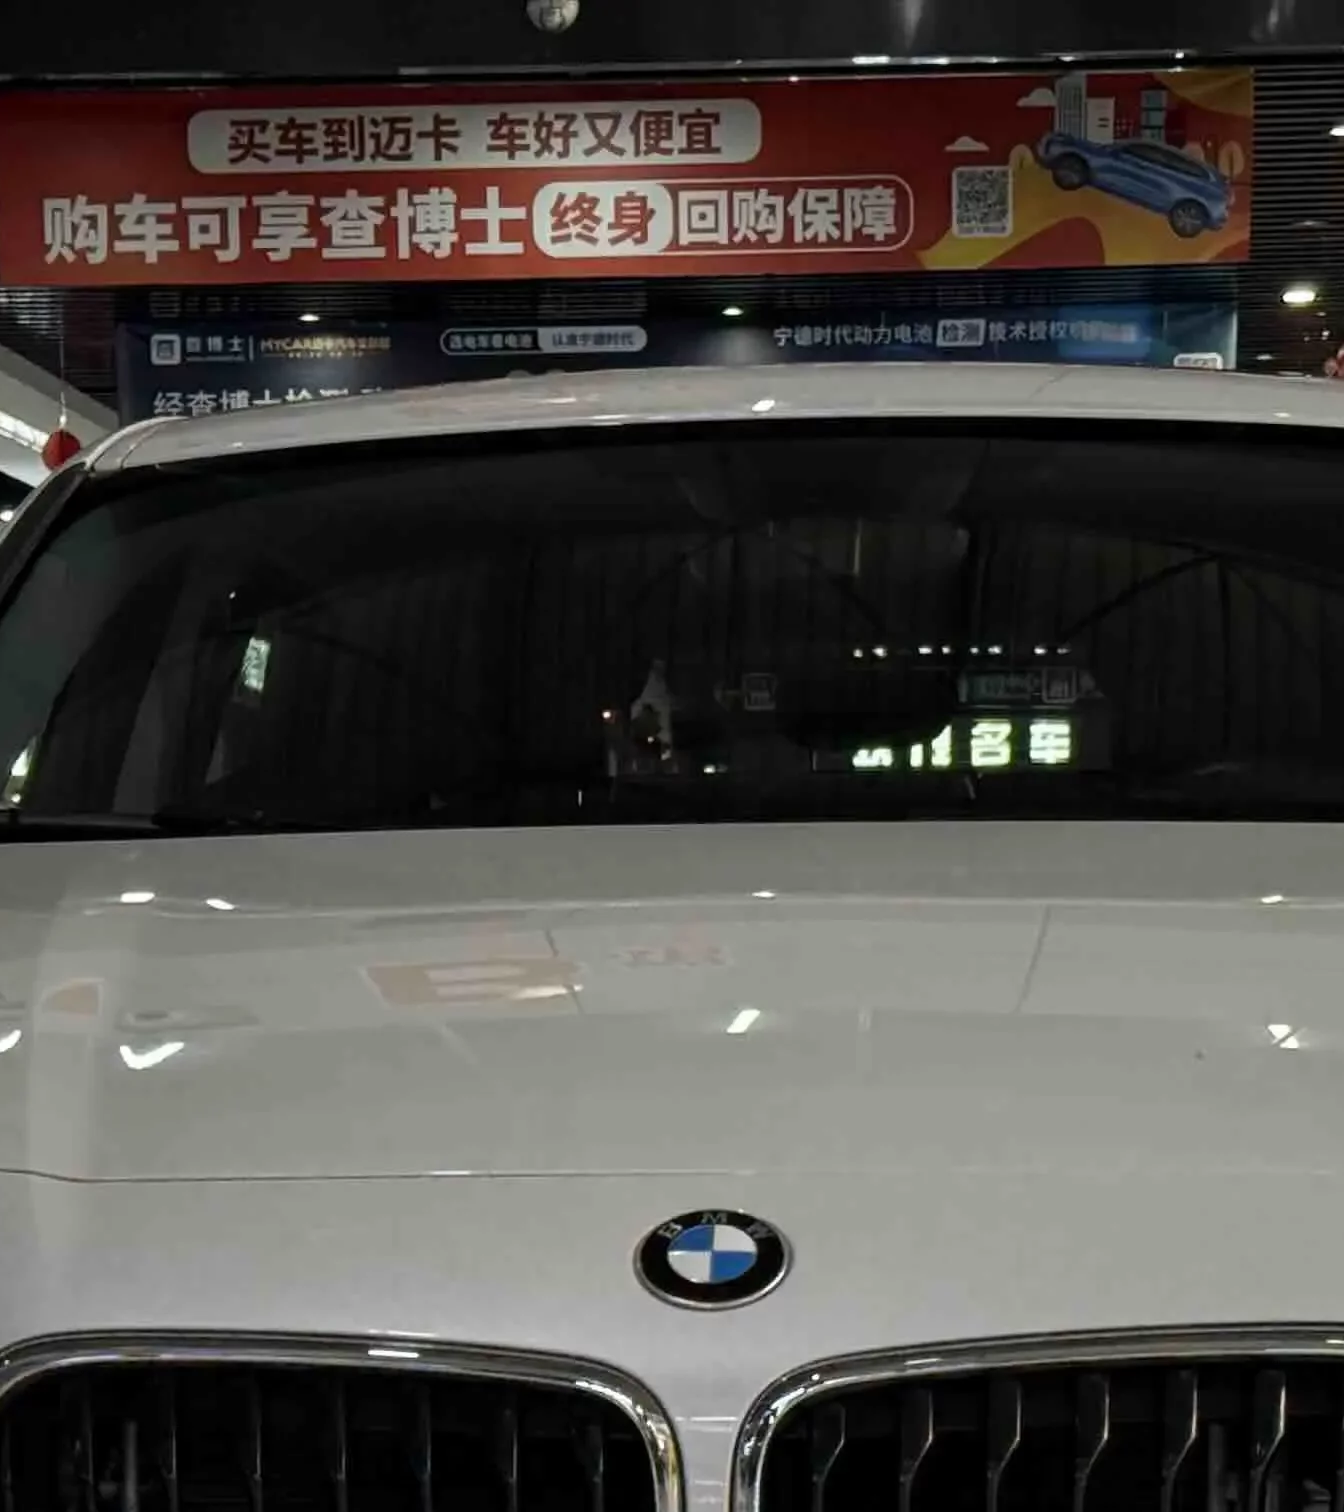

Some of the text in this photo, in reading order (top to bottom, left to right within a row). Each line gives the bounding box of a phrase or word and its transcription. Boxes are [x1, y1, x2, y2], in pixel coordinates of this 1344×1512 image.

[227, 107, 723, 166] 买车到迈卡 车好又便宜
[42, 186, 899, 265] 购车可享查博士 终身 回购保障
[657, 1211, 775, 1240] BMW
